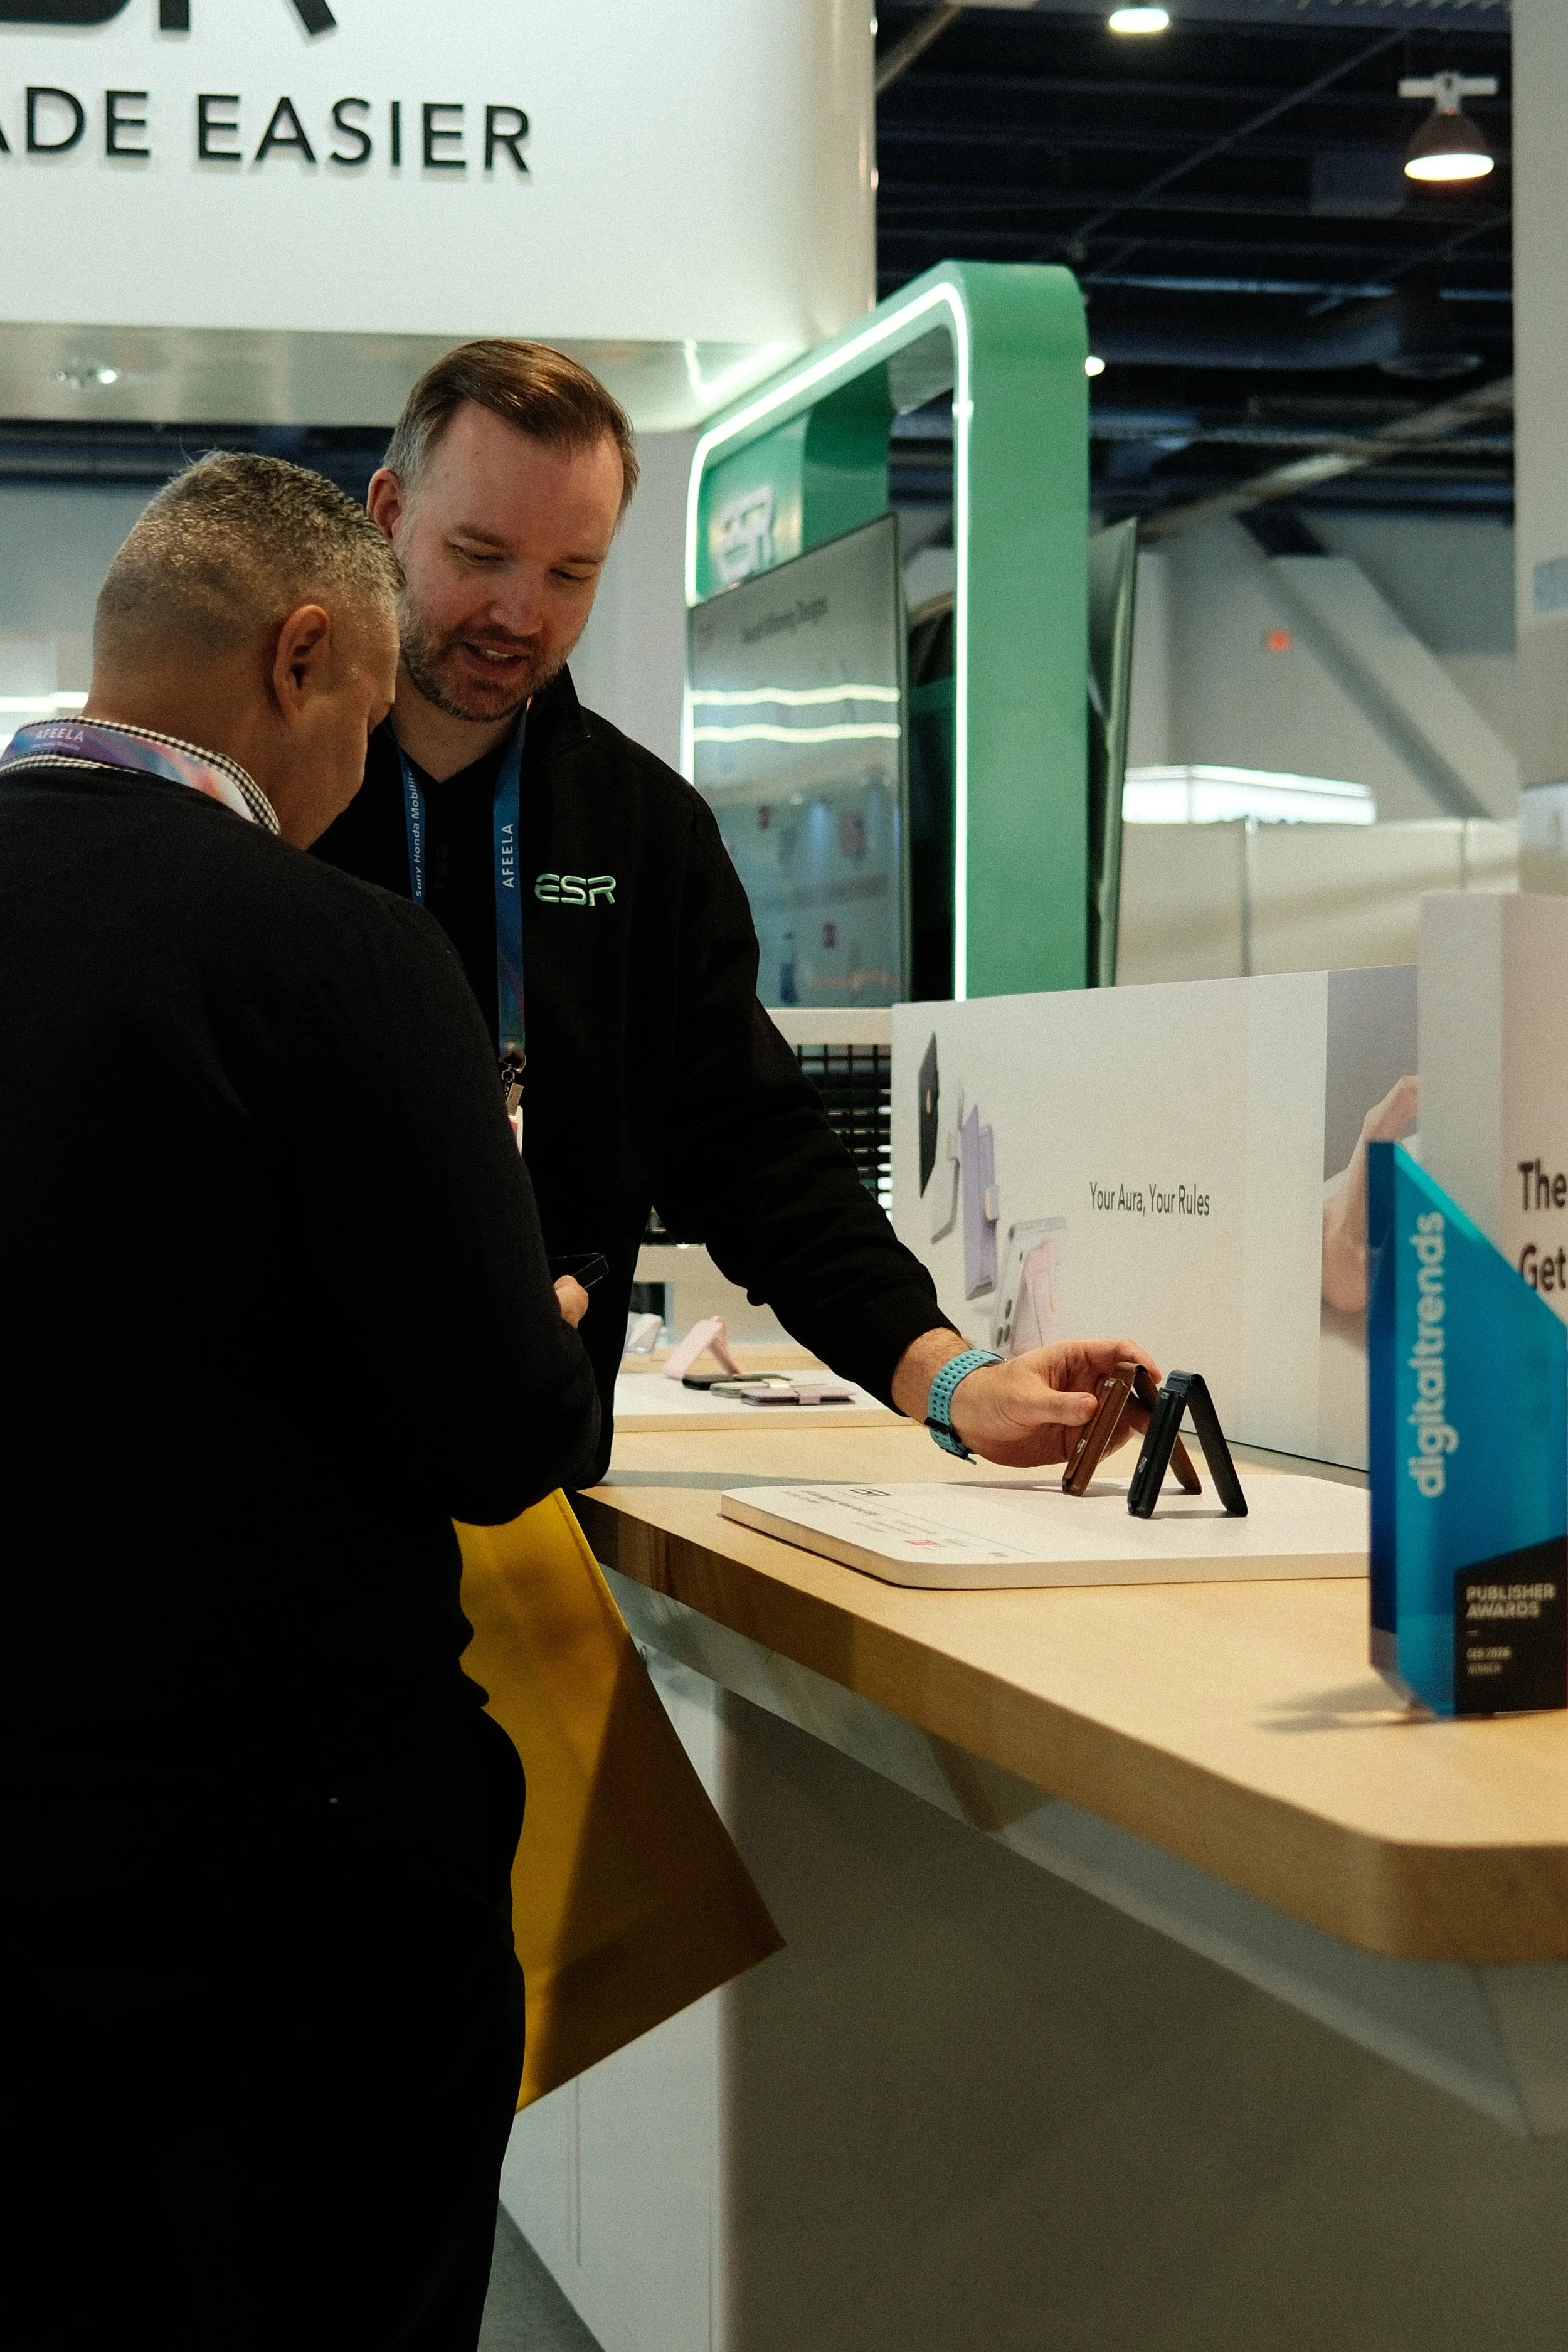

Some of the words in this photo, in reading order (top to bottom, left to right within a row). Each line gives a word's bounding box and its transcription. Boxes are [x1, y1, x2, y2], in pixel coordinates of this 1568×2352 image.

[0, 87, 151, 157] DE
[197, 93, 529, 172] EASIER
[34, 728, 84, 743] AFEELA
[411, 822, 421, 864] Honda
[501, 823, 515, 889] AFEELA
[534, 873, 617, 906] ESR
[1089, 1181, 1115, 1210] Your
[1117, 1183, 1145, 1217] Aura,
[1149, 1184, 1175, 1214] Your
[1179, 1183, 1210, 1216] Rules
[1518, 1157, 1567, 1210] The
[1518, 1243, 1567, 1291] Get
[1407, 1210, 1459, 1498] digitaltrends
[1466, 1583, 1557, 1601] PUBLISHER
[1466, 1601, 1541, 1619] AWARDS
